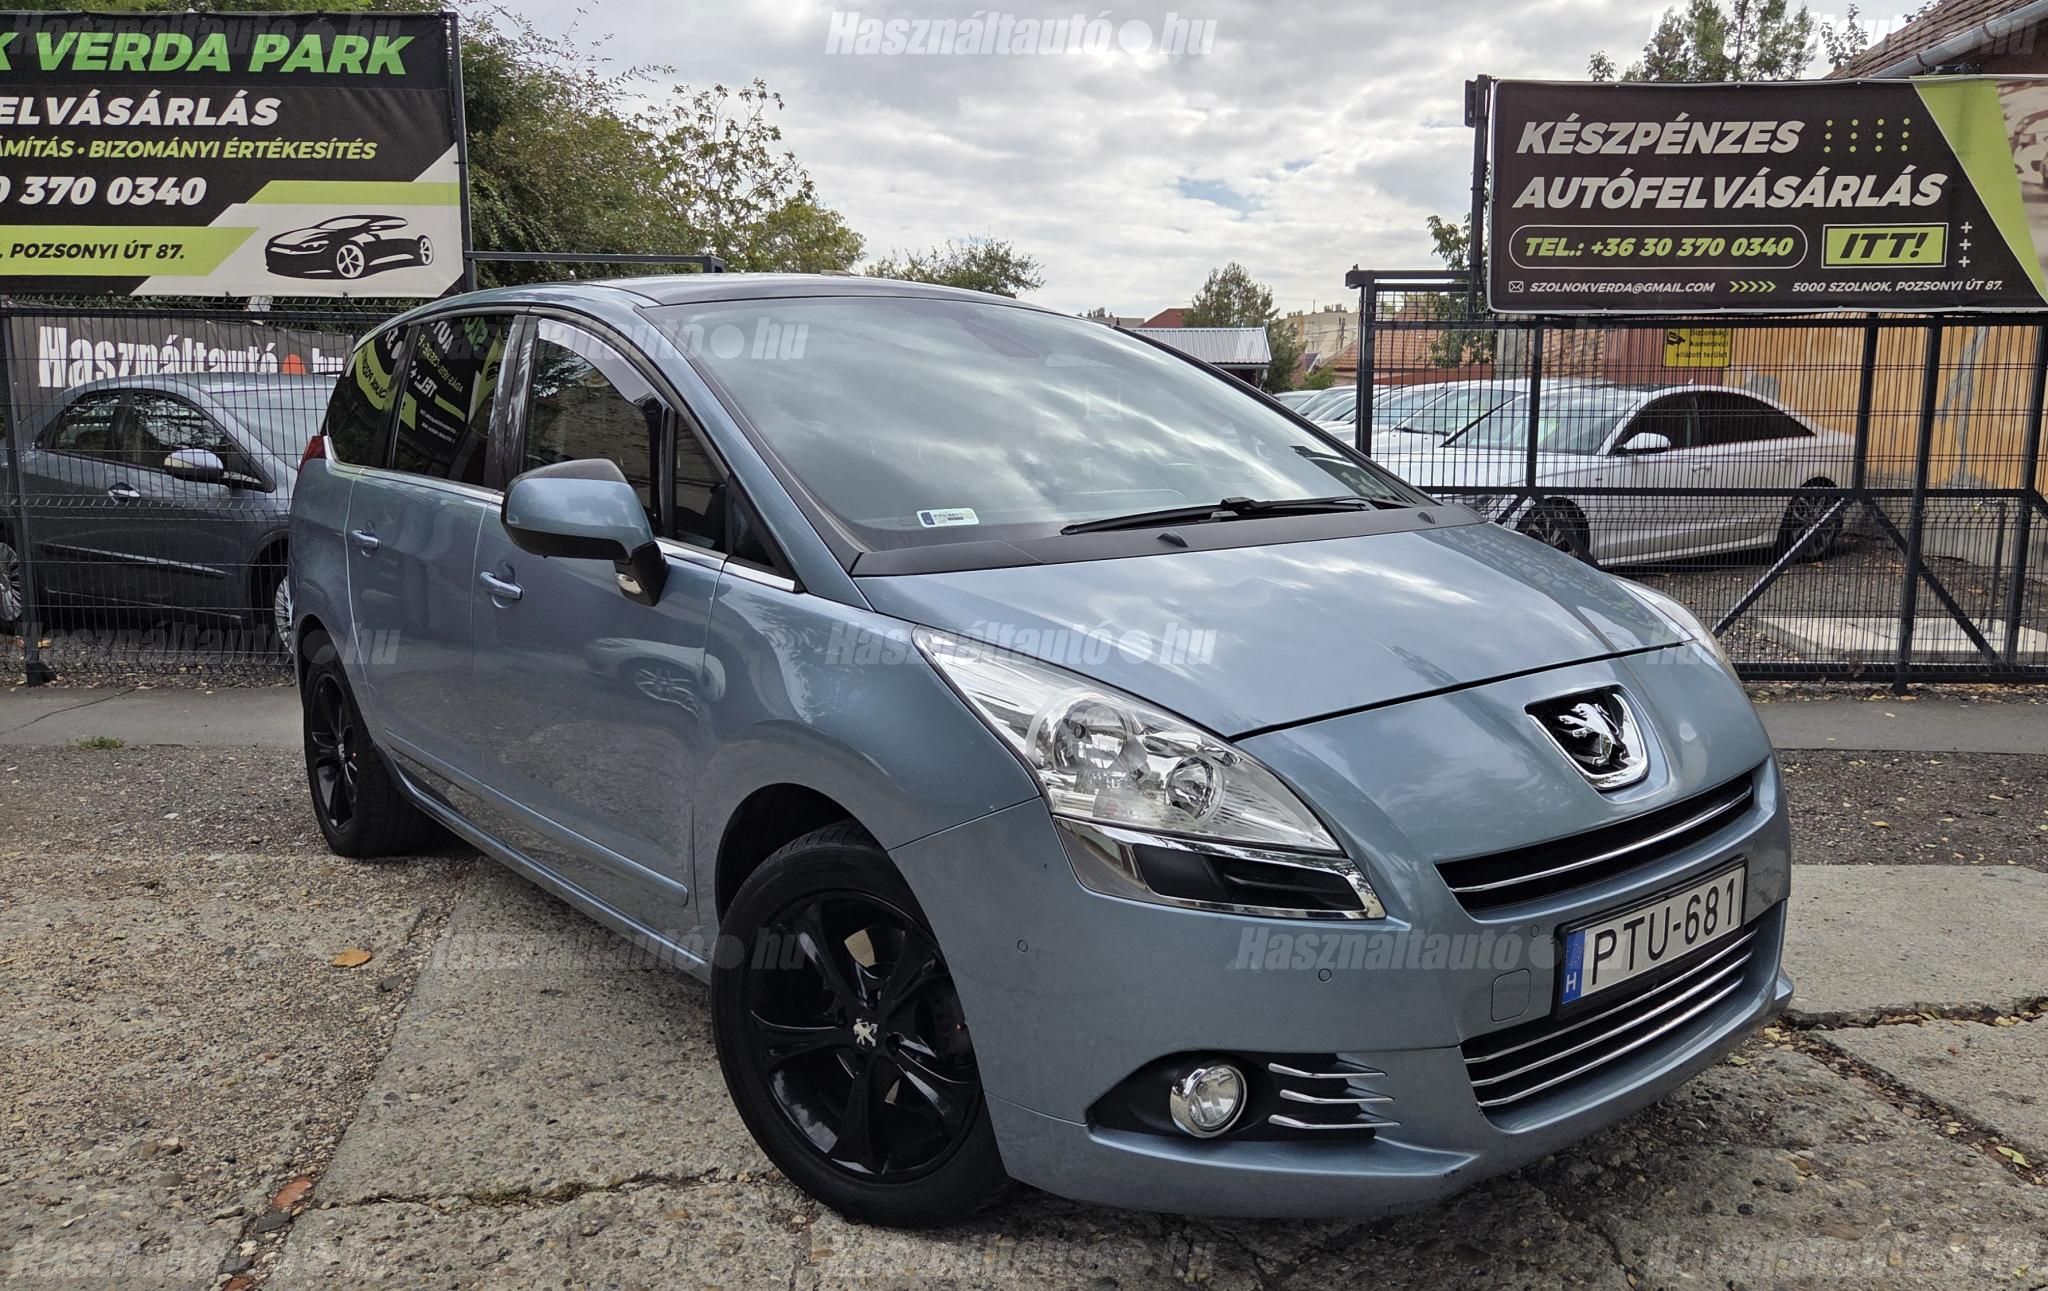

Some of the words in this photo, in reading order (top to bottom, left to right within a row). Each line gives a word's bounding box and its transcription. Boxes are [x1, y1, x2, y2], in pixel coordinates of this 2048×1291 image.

[36, 32, 231, 72] VERDA
[248, 34, 415, 75] PARK
[1516, 112, 1805, 155] KÉSZPÉNZES
[89, 137, 219, 159] BIZOMÁNYI
[222, 138, 377, 160] ÉRTÉKESÍTÉS
[19, 176, 97, 205] 370
[107, 177, 207, 206] 0340
[1512, 164, 1948, 209] AUTÓFELVÁSÁRLÁS
[10, 243, 119, 259] POZSONYI
[122, 240, 153, 259] ÚT
[155, 244, 185, 259] 87.
[1525, 237, 1585, 257] TEL.:
[1590, 238, 1635, 257] +36
[1639, 238, 1673, 257] 30
[1677, 238, 1725, 257] 370
[1730, 237, 1794, 257] 0340
[1839, 232, 1929, 259] ITT!
[1530, 281, 1716, 294] SZOLNOKVERDA@GMAIL.COM
[1792, 282, 1826, 292] 5000
[1828, 281, 1892, 293] SZOLNOK,
[1896, 280, 1963, 292] POZSONYI
[1965, 278, 1985, 291] ÚT
[1566, 972, 1577, 993] H
[1592, 877, 1735, 986] PTU-681
